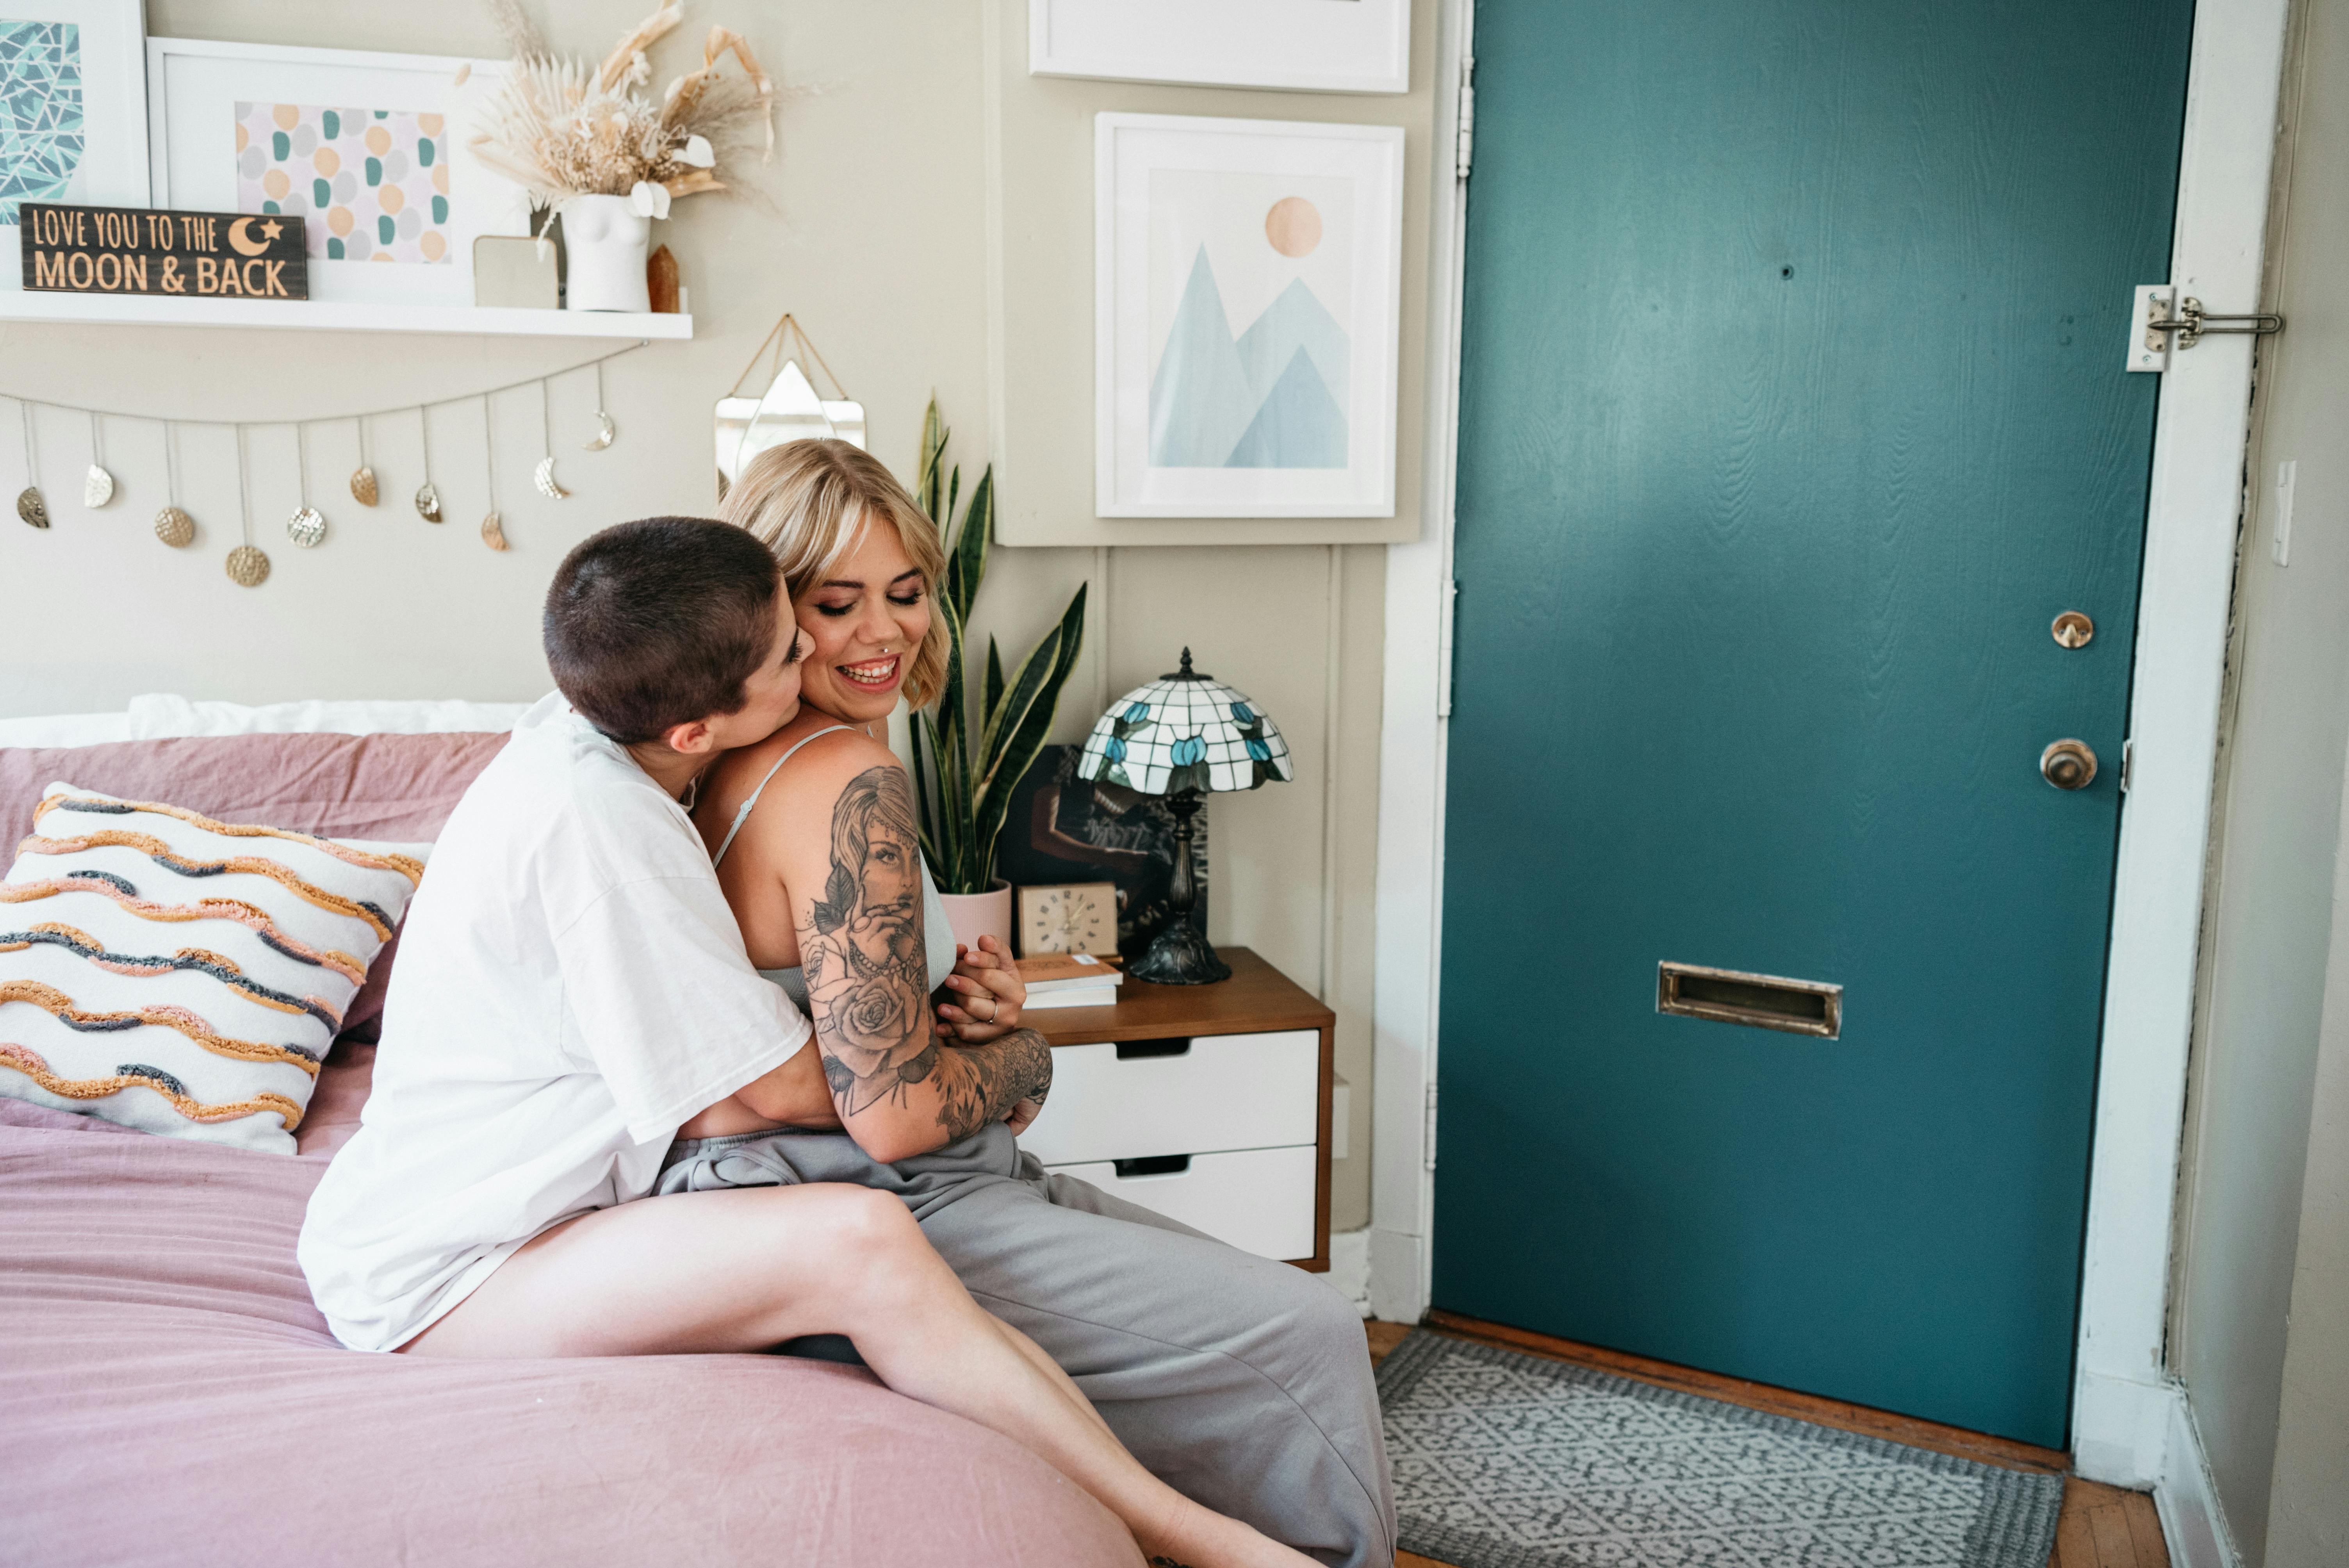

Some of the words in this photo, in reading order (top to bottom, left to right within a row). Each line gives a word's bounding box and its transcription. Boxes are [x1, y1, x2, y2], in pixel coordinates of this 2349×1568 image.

[34, 210, 87, 246] LOVE
[94, 213, 138, 248] YOU
[146, 216, 173, 250] TO
[181, 217, 218, 252] THE
[35, 251, 148, 290] MOON
[161, 256, 185, 292] &
[197, 257, 288, 296] BACK
[1051, 894, 1058, 903] 11
[1064, 890, 1071, 899] 12
[1079, 941, 1085, 949] 5
